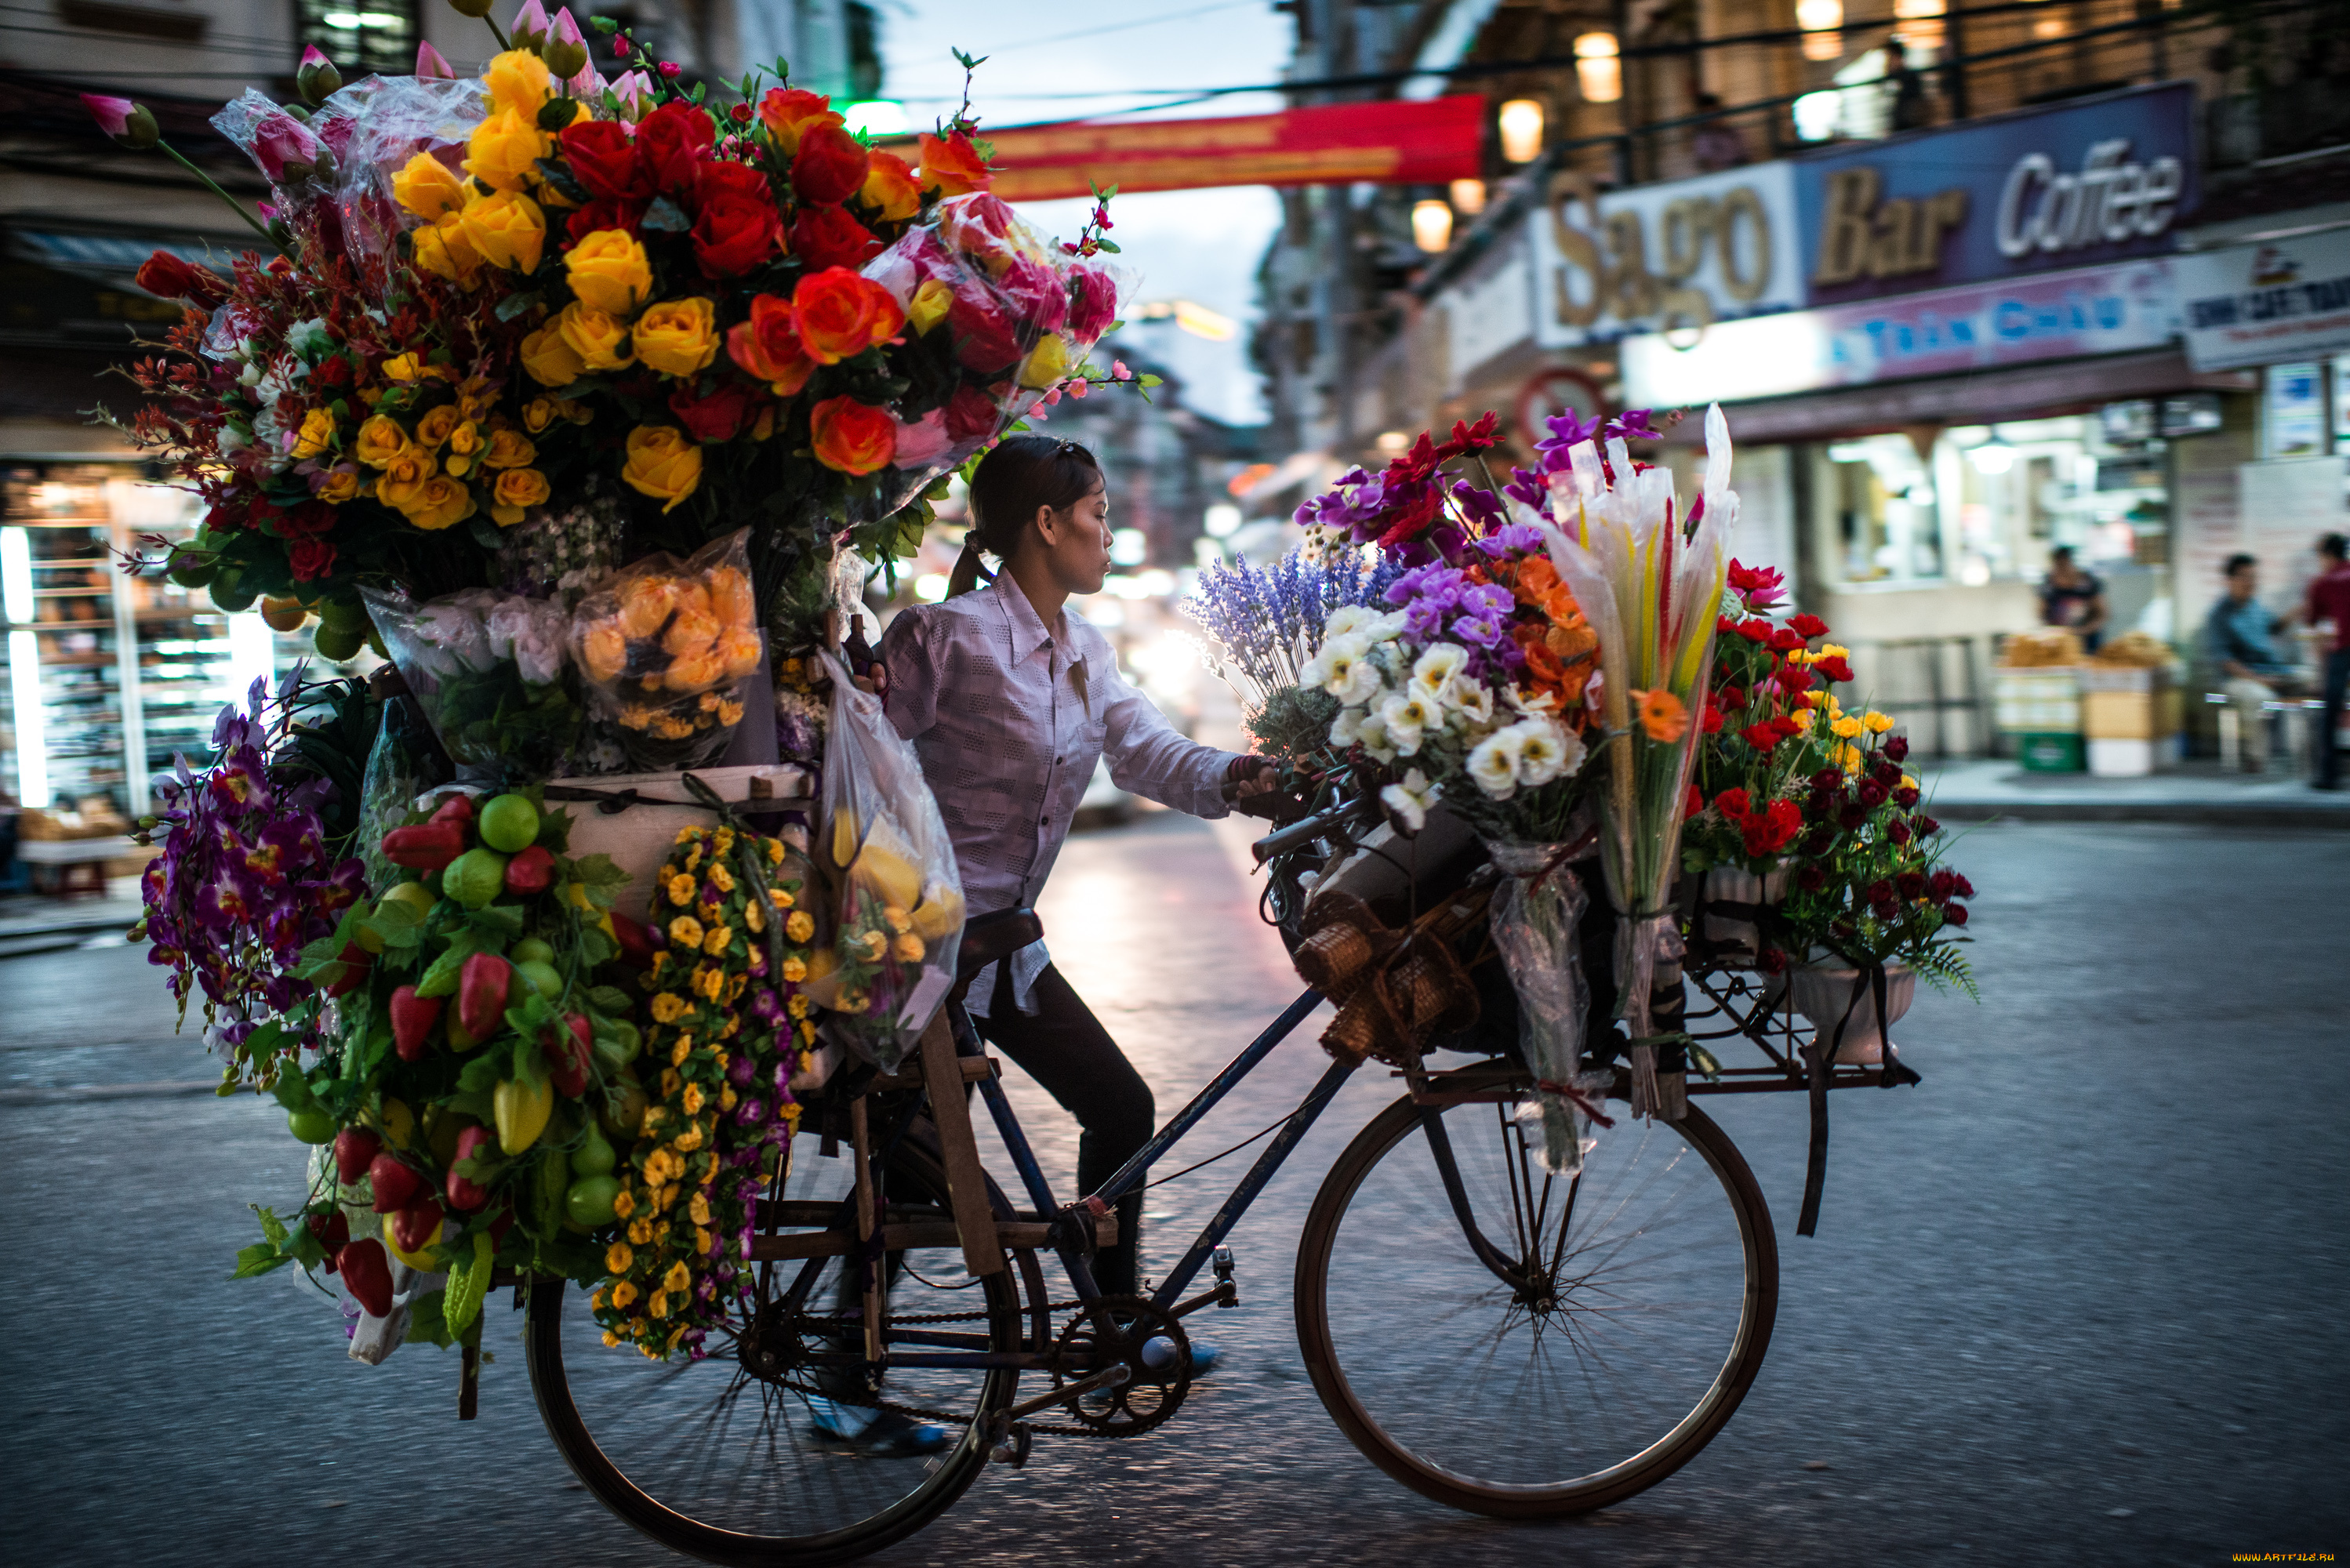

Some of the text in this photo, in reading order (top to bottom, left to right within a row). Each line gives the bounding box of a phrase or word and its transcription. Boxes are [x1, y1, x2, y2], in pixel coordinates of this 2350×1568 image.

[1548, 138, 2183, 352] Sago Bar Coffee
